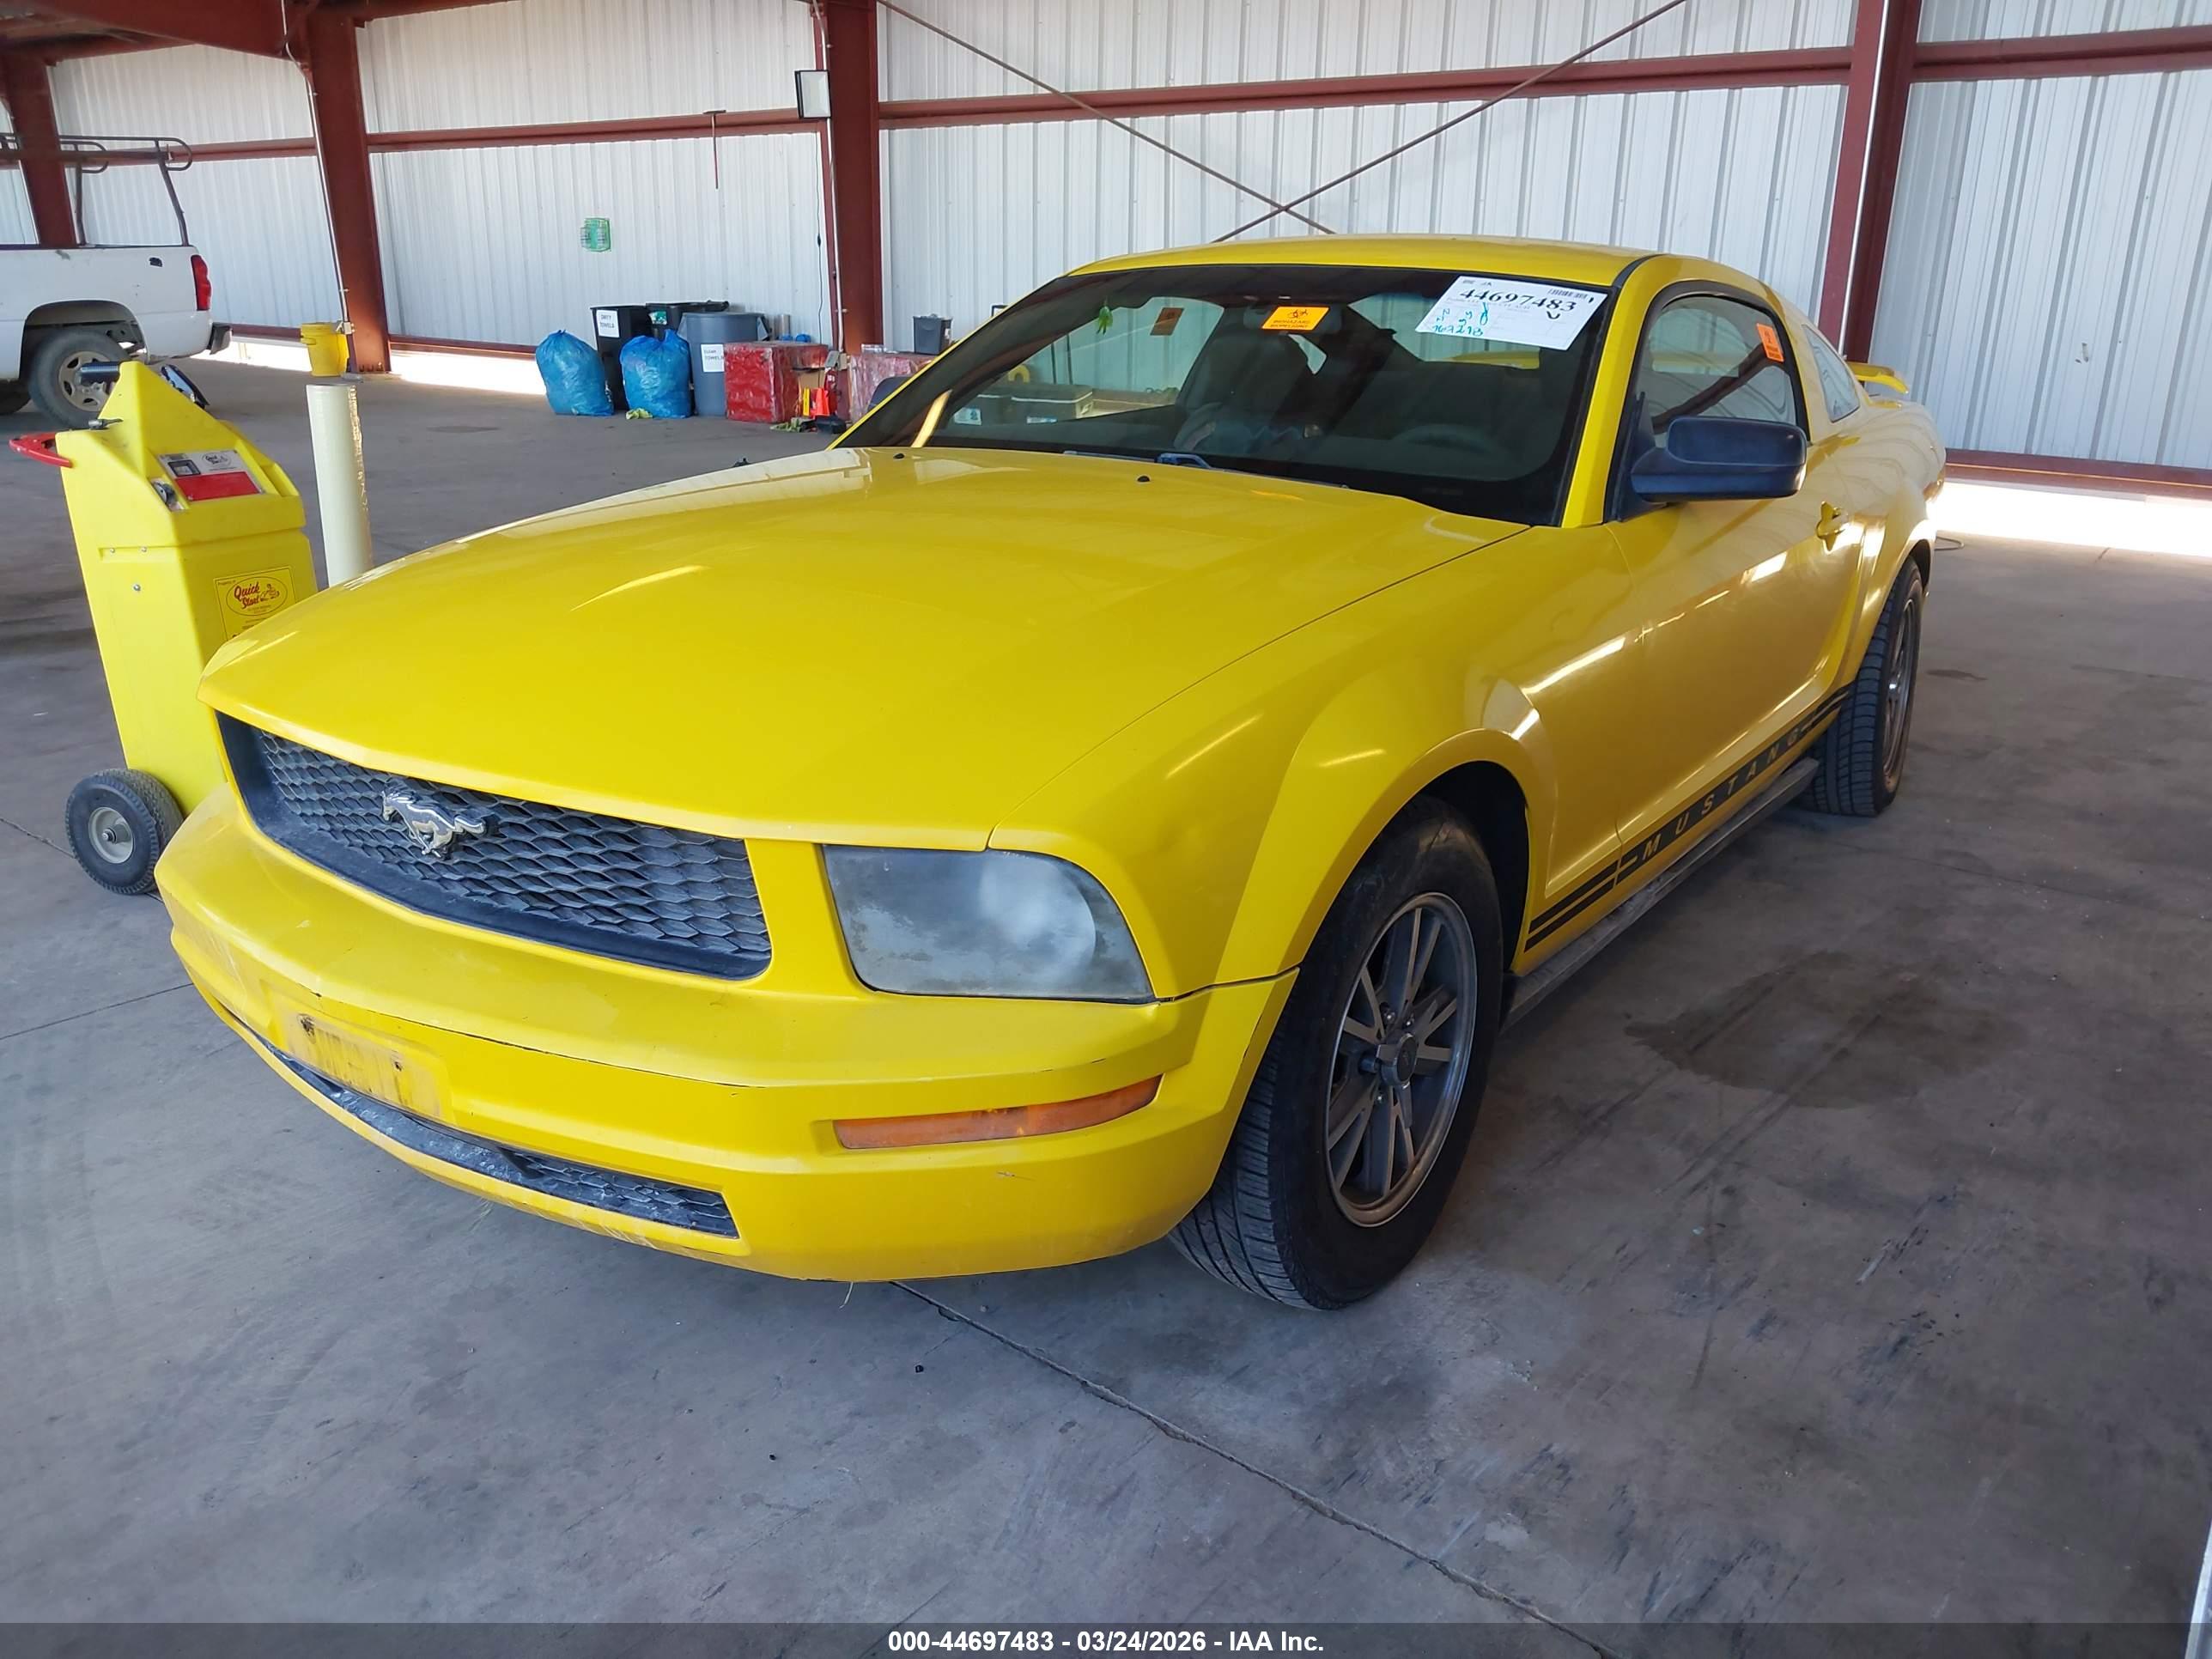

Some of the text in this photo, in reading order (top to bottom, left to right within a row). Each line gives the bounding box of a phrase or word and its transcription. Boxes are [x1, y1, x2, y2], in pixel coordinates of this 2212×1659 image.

[1460, 289, 1577, 312] 44697483
[234, 581, 260, 601] Quick
[241, 595, 259, 609] Start
[1642, 728, 1799, 861] MUSTANG
